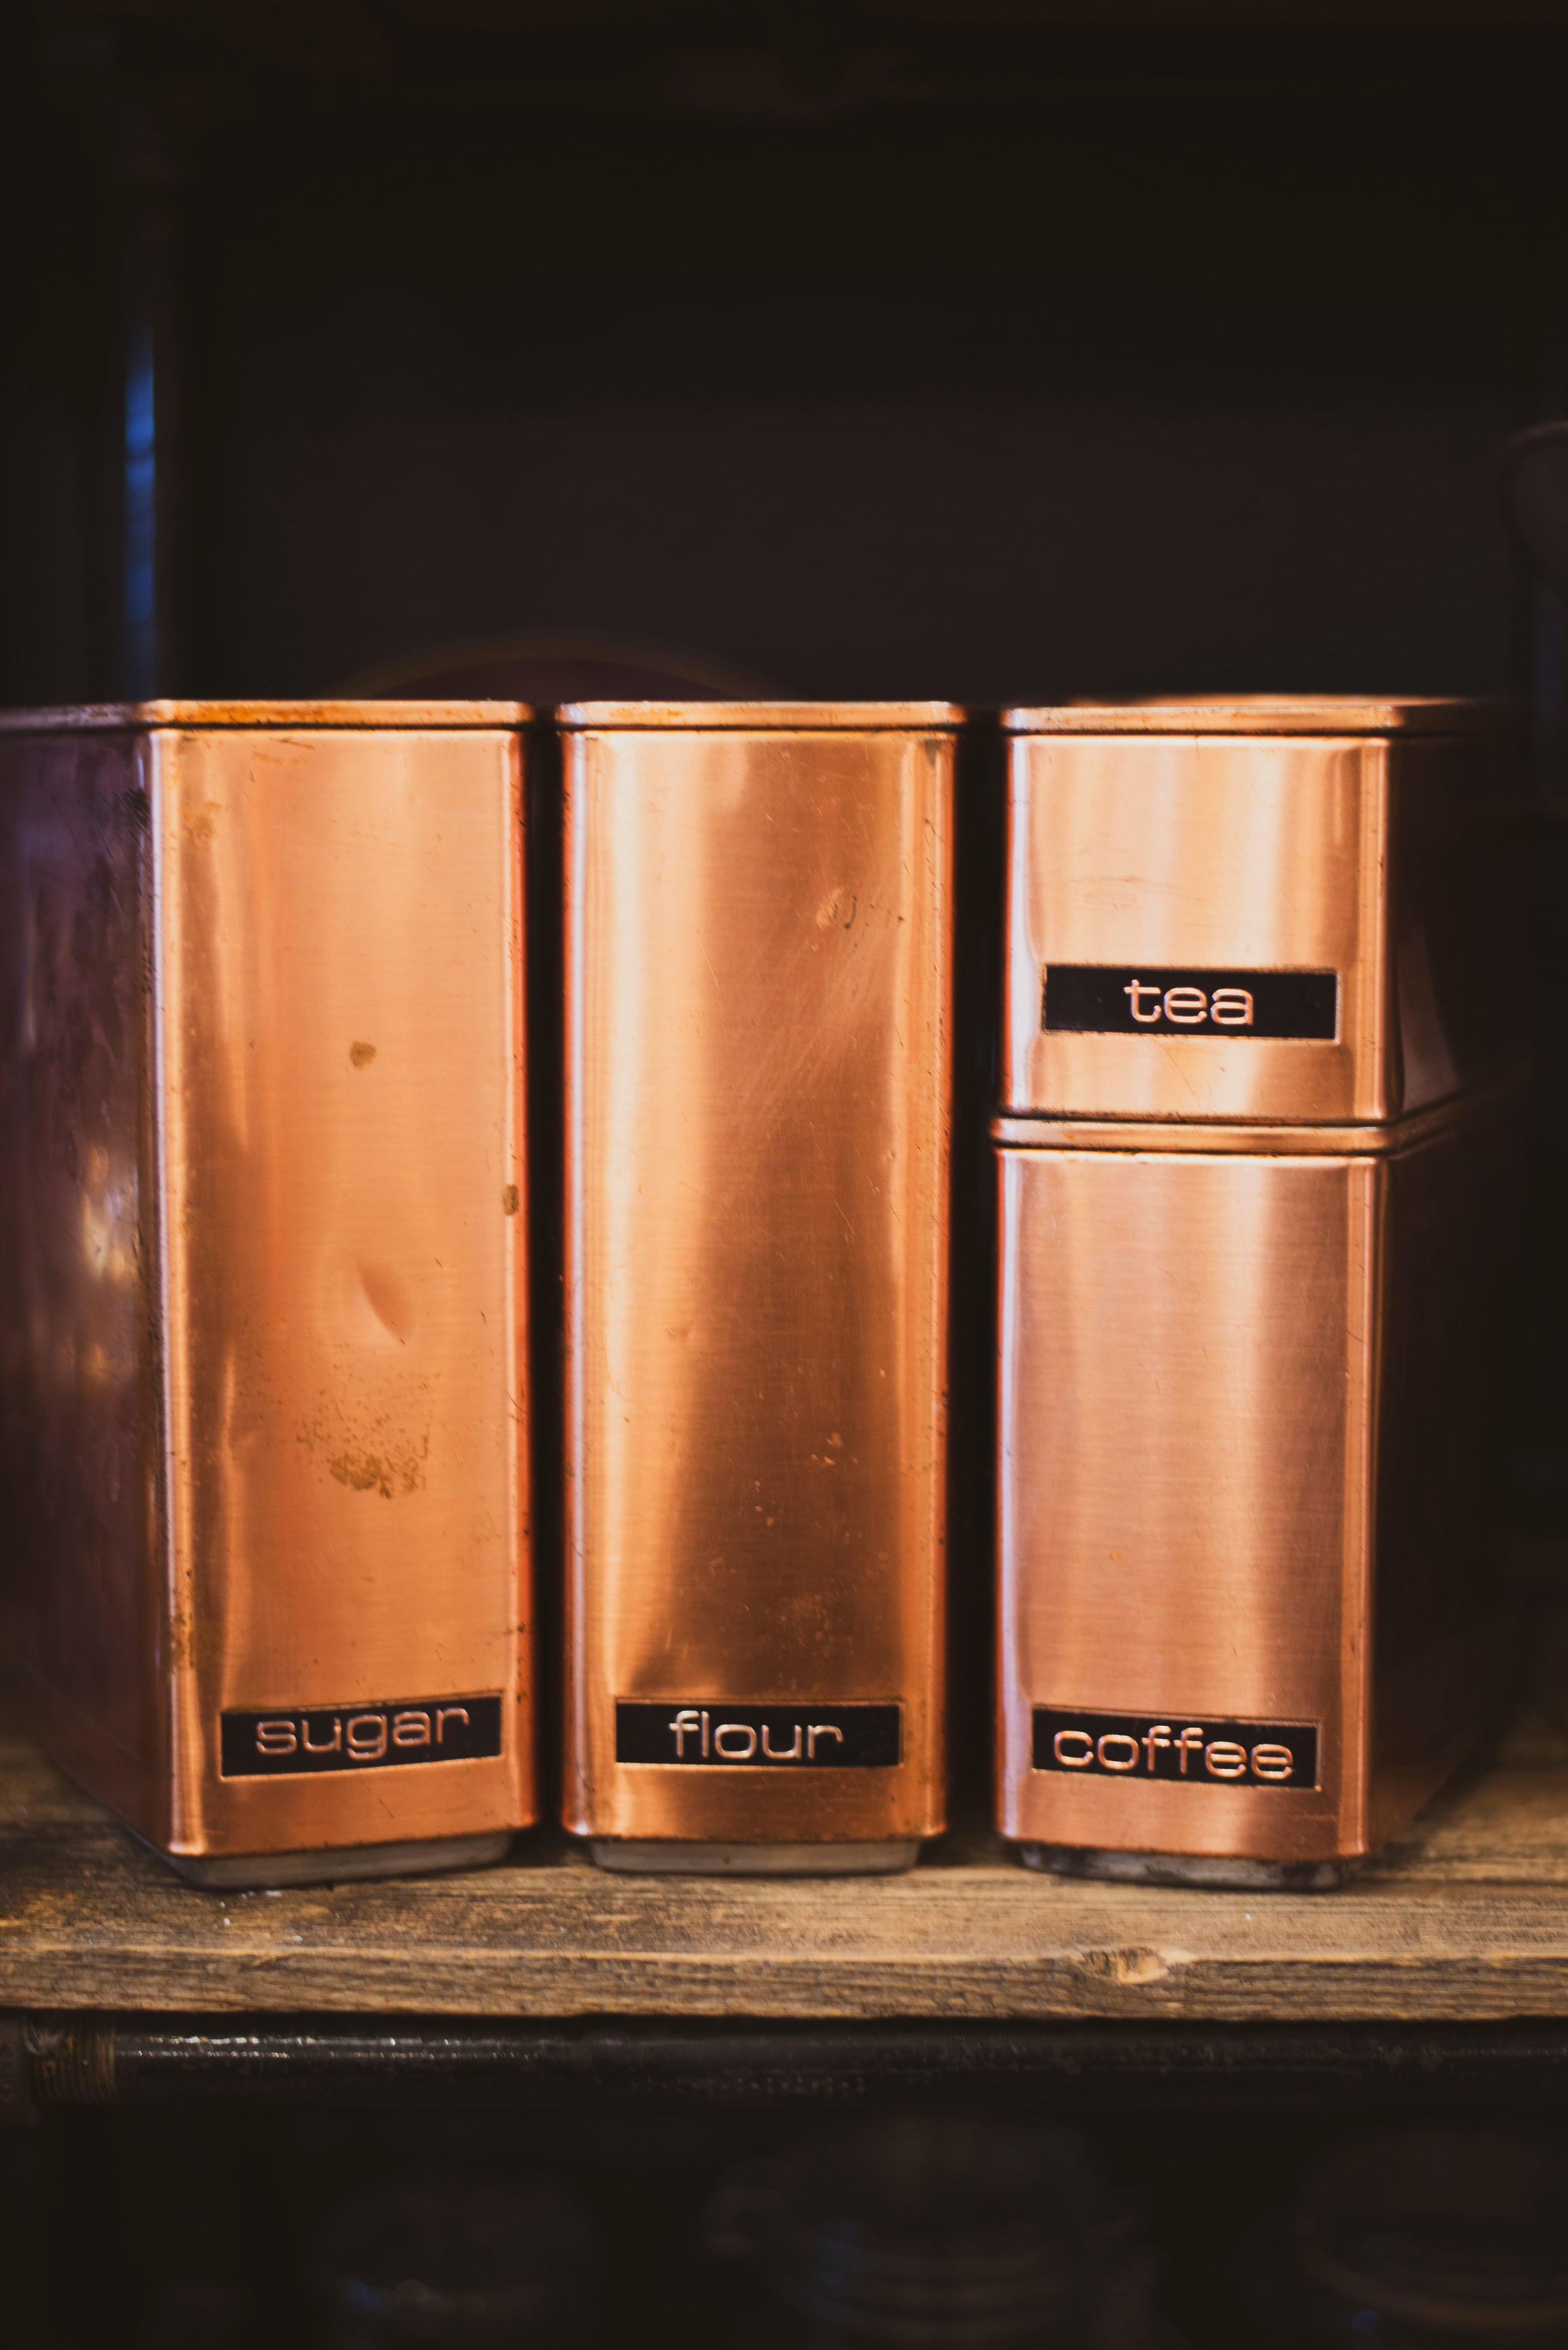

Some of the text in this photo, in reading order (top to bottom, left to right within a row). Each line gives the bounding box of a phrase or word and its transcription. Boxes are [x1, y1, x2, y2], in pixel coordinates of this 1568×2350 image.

[1124, 979, 1254, 1025] tea
[255, 1708, 470, 1760] sugar
[668, 1710, 843, 1759] flour
[1053, 1725, 1294, 1780] coffee
